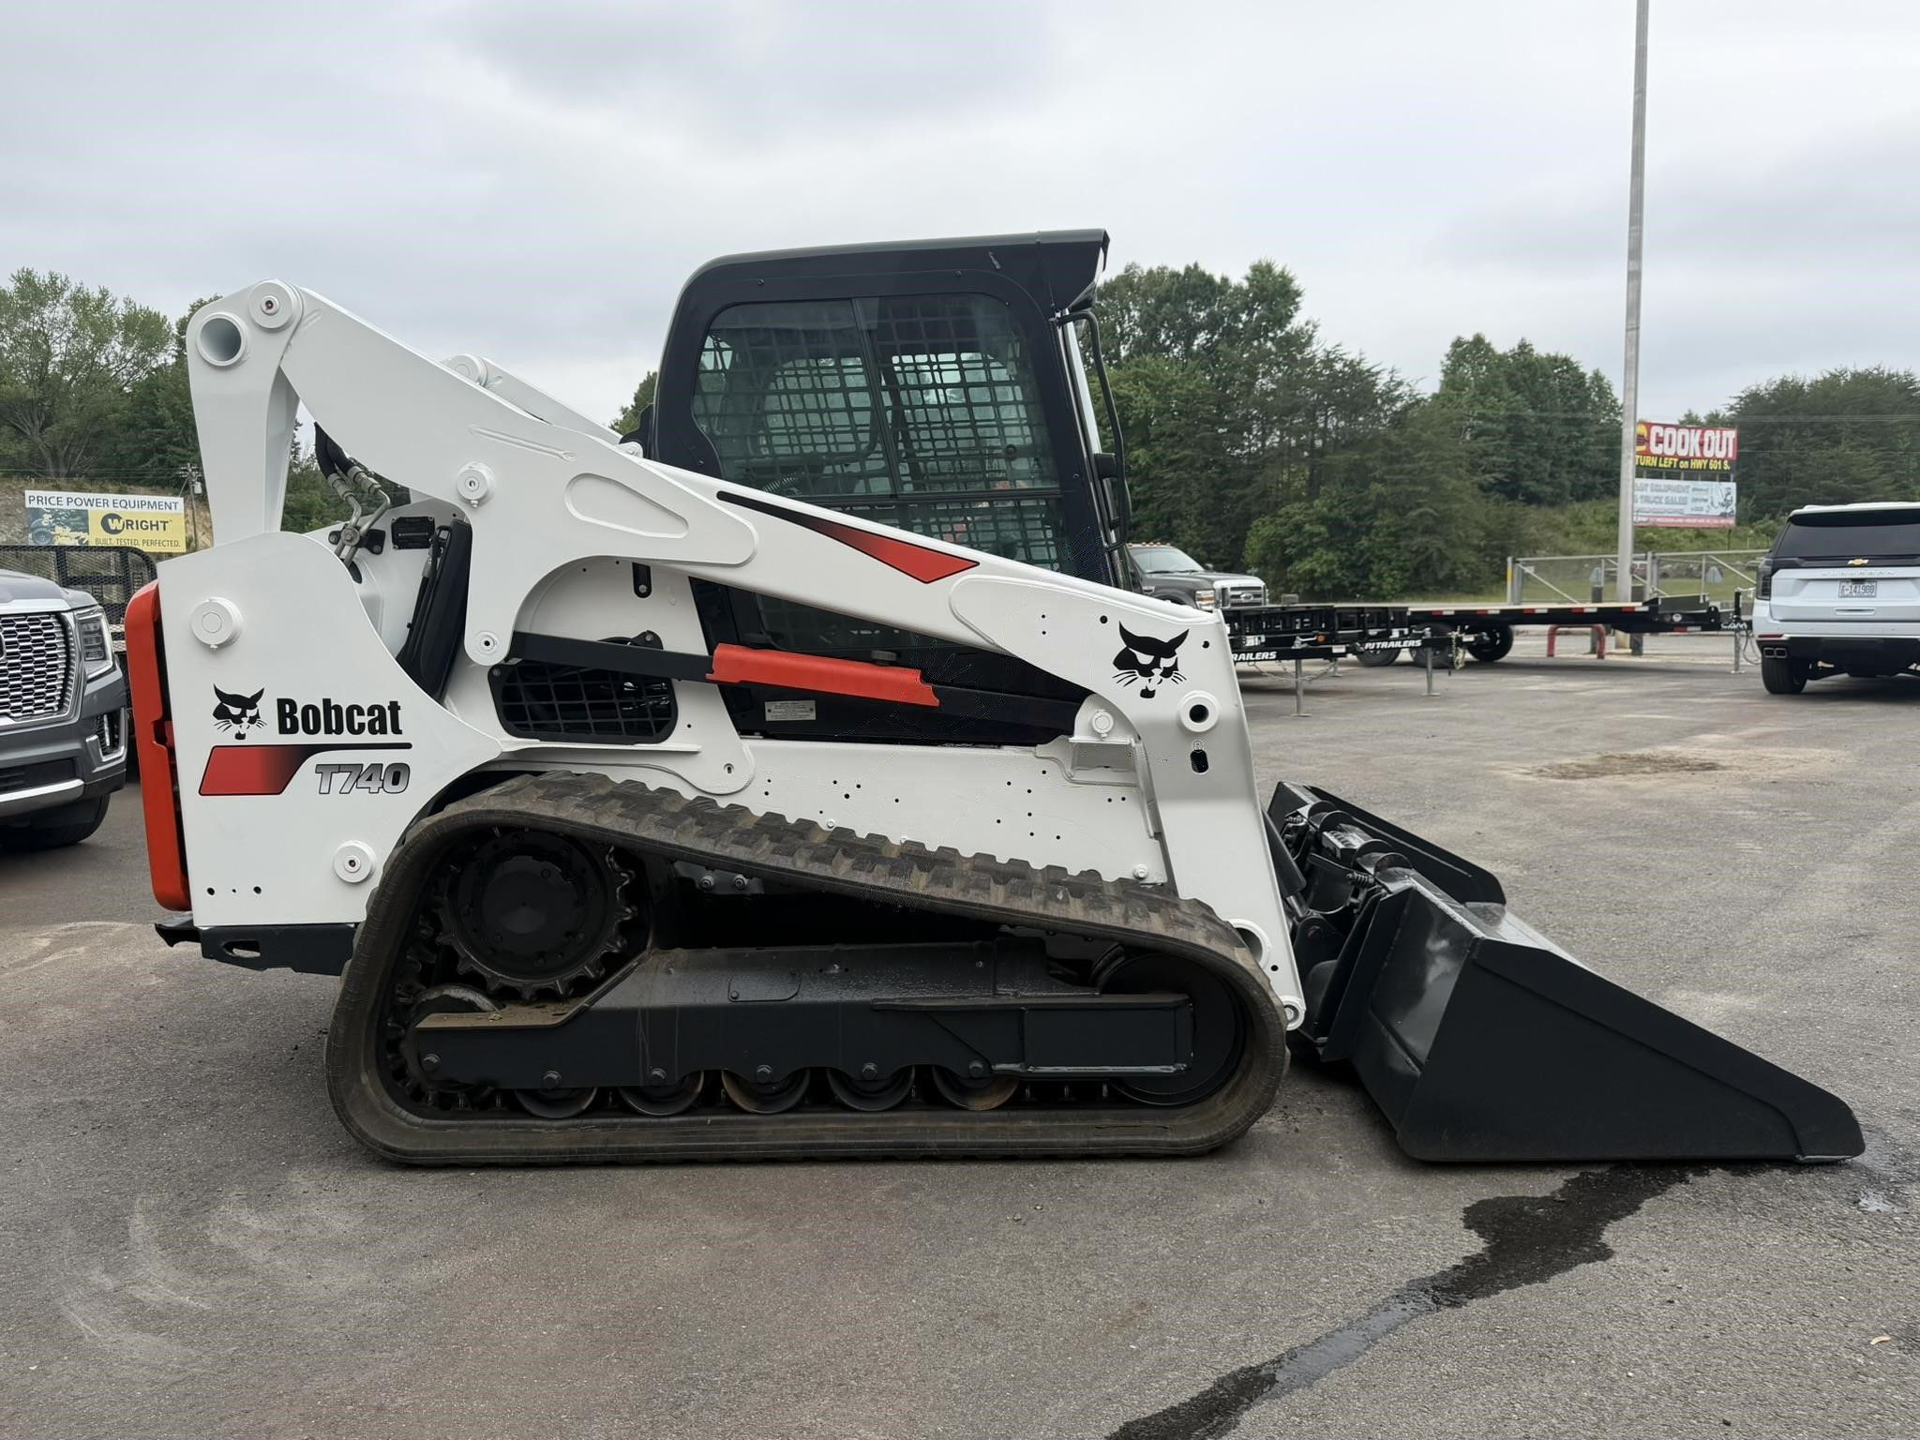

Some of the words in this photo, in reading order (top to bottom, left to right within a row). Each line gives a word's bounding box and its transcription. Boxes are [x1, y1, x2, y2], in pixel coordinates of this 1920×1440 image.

[1650, 426, 1701, 456] COOK
[1703, 430, 1736, 457] OUT
[1635, 455, 1657, 466] TURN
[1659, 457, 1678, 468] LEFT
[1679, 460, 1688, 469] on
[1690, 459, 1708, 470] HWY
[28, 495, 63, 506] PRICE
[67, 497, 109, 508] POWER
[113, 499, 179, 511] EQUIPMENT
[104, 516, 169, 532] WRIGHT
[1376, 639, 1422, 649] TRAILERS
[277, 698, 403, 735] Bobcat
[315, 762, 411, 795] T740
